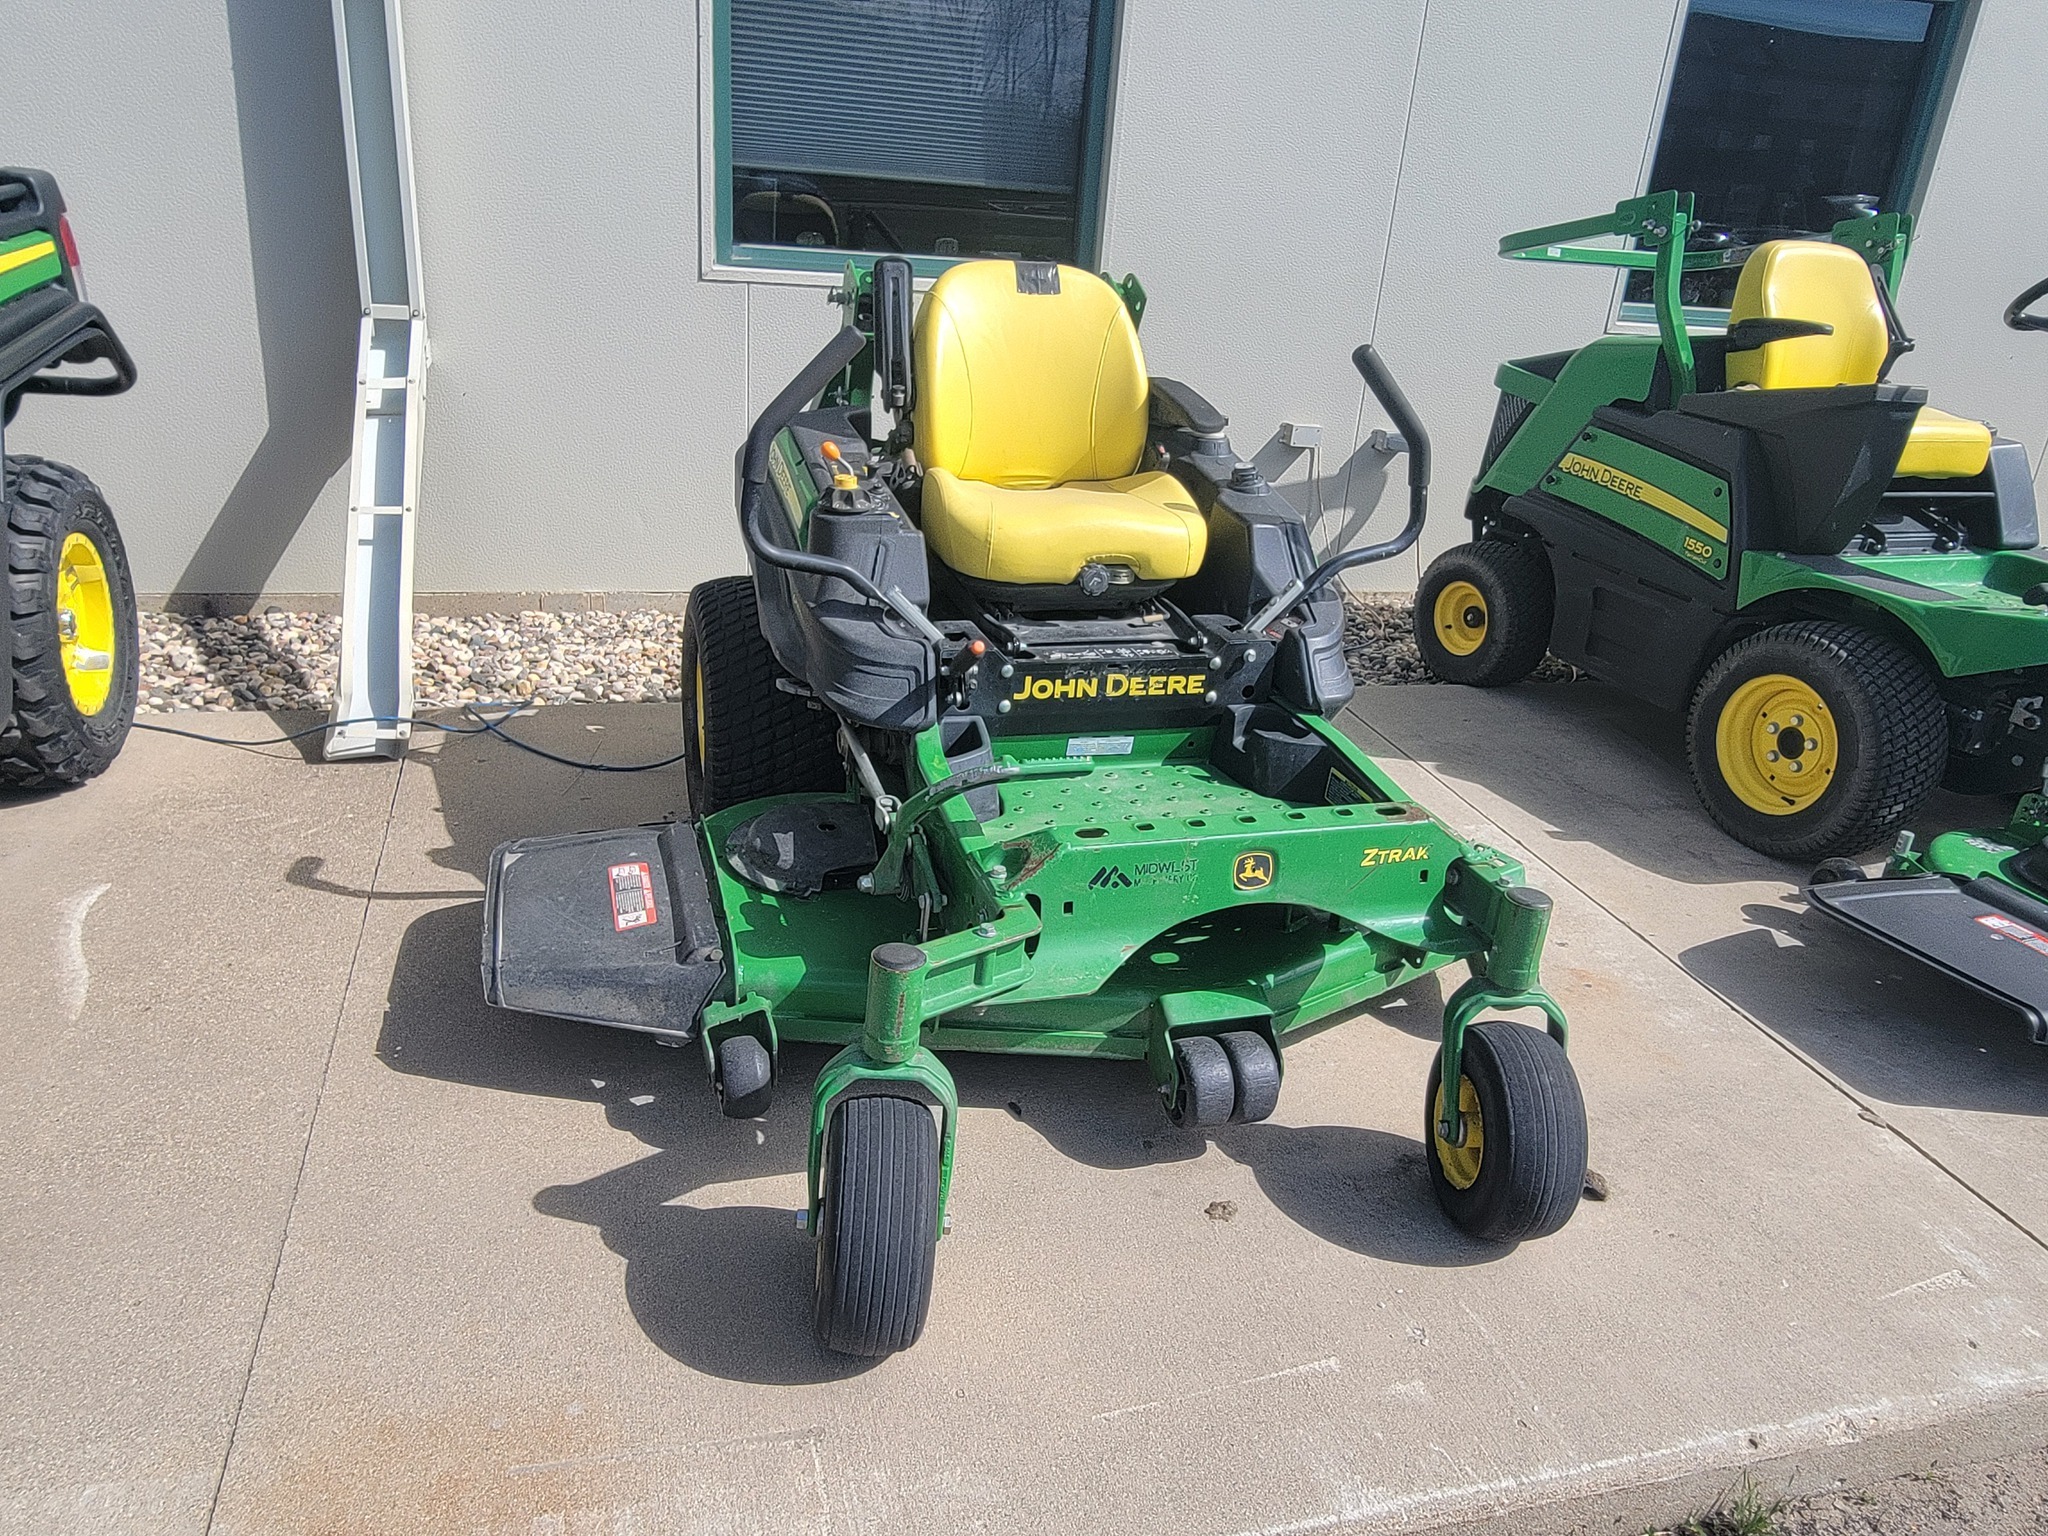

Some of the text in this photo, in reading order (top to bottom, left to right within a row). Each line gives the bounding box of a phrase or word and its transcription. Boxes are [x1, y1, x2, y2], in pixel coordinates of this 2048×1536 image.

[1565, 457, 1643, 498] JOHN DEERE
[1683, 536, 1713, 558] 1550
[1013, 673, 1206, 700] JOHN DEERE
[1360, 846, 1429, 867] ZTRAK
